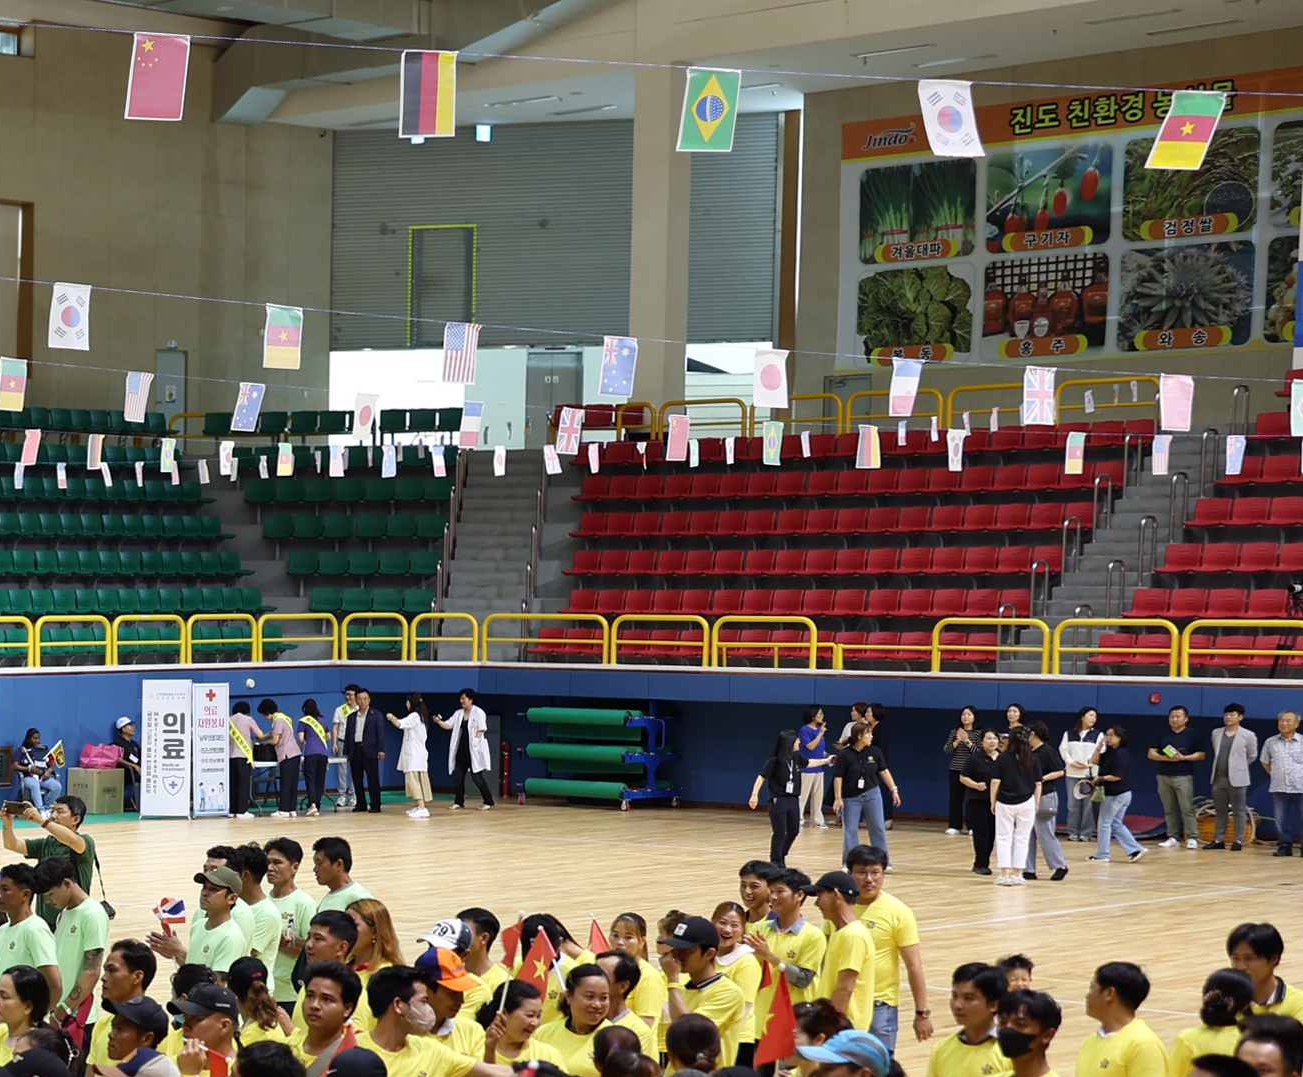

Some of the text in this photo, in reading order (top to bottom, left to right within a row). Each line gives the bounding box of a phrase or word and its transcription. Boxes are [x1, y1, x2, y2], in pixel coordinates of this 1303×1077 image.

[1009, 78, 1237, 136] 진도 친환경 농물
[861, 133, 908, 150] Jindo
[1163, 215, 1215, 236] 검정쌀
[1023, 229, 1071, 248] 구기자
[890, 241, 943, 259] 겨울대파
[204, 705, 218, 716] 의료
[197, 717, 225, 728] 자원봉사
[162, 712, 186, 760] 의료
[433, 923, 449, 937] 79
